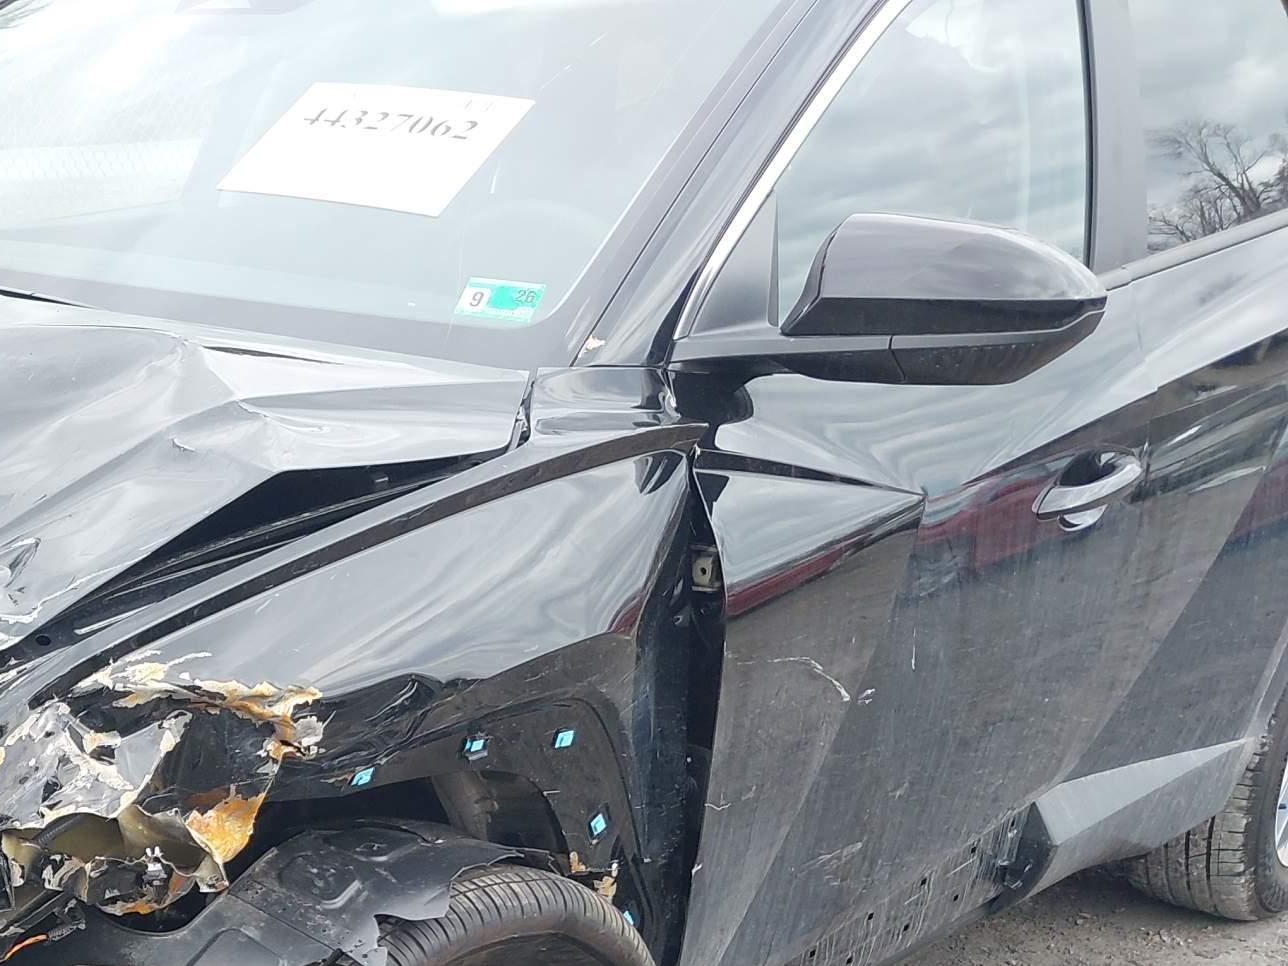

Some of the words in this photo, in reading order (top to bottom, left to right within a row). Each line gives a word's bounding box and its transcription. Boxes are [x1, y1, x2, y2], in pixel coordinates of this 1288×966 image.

[303, 107, 479, 140] 44327062
[468, 290, 485, 307] 9
[513, 288, 538, 305] 26
